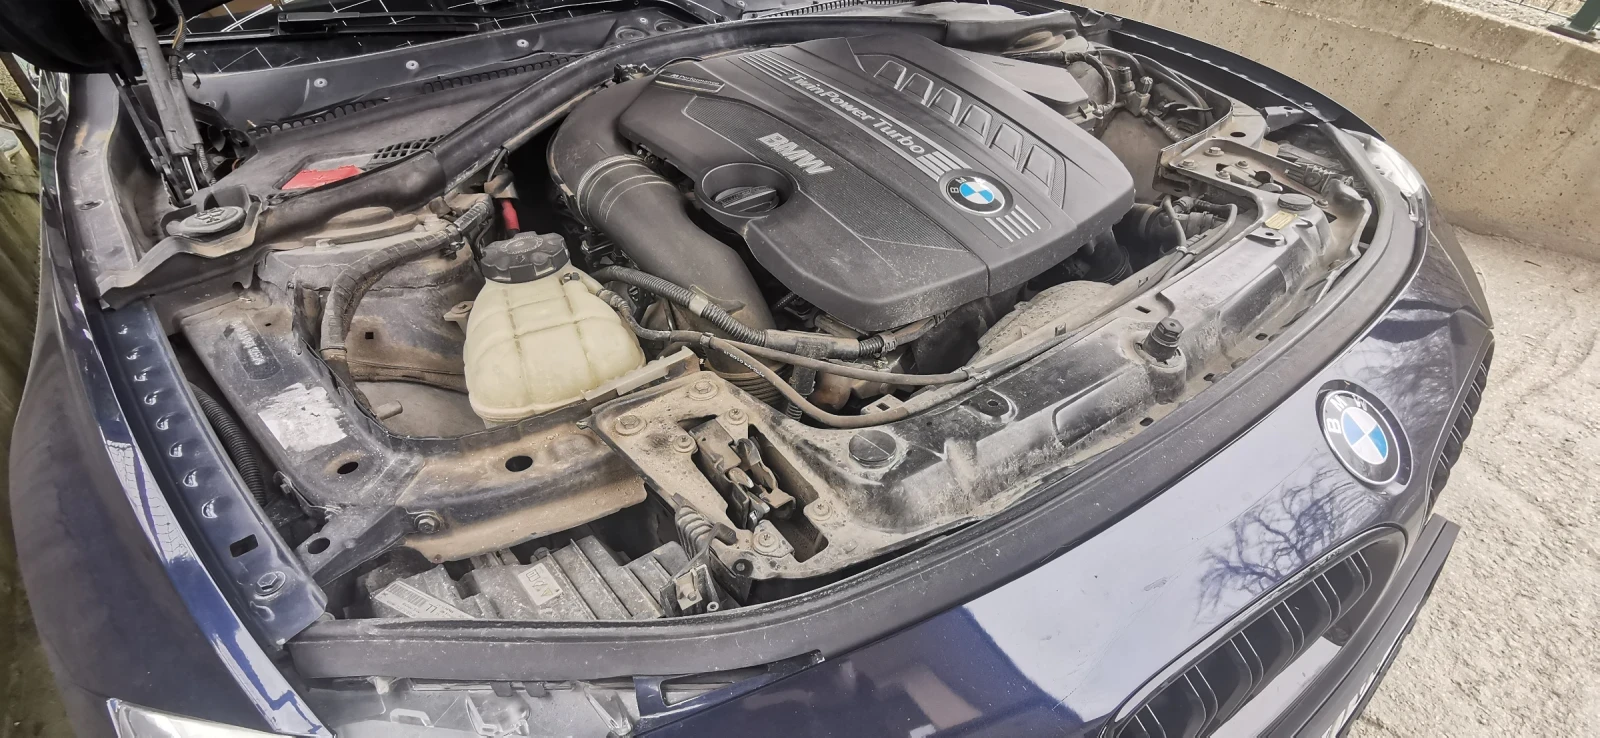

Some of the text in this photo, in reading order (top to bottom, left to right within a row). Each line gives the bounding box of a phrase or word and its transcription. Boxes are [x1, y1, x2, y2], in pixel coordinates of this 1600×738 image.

[788, 73, 925, 155] TwinPower Turbo
[756, 132, 835, 175] BMW
[1326, 393, 1368, 434] BMW
